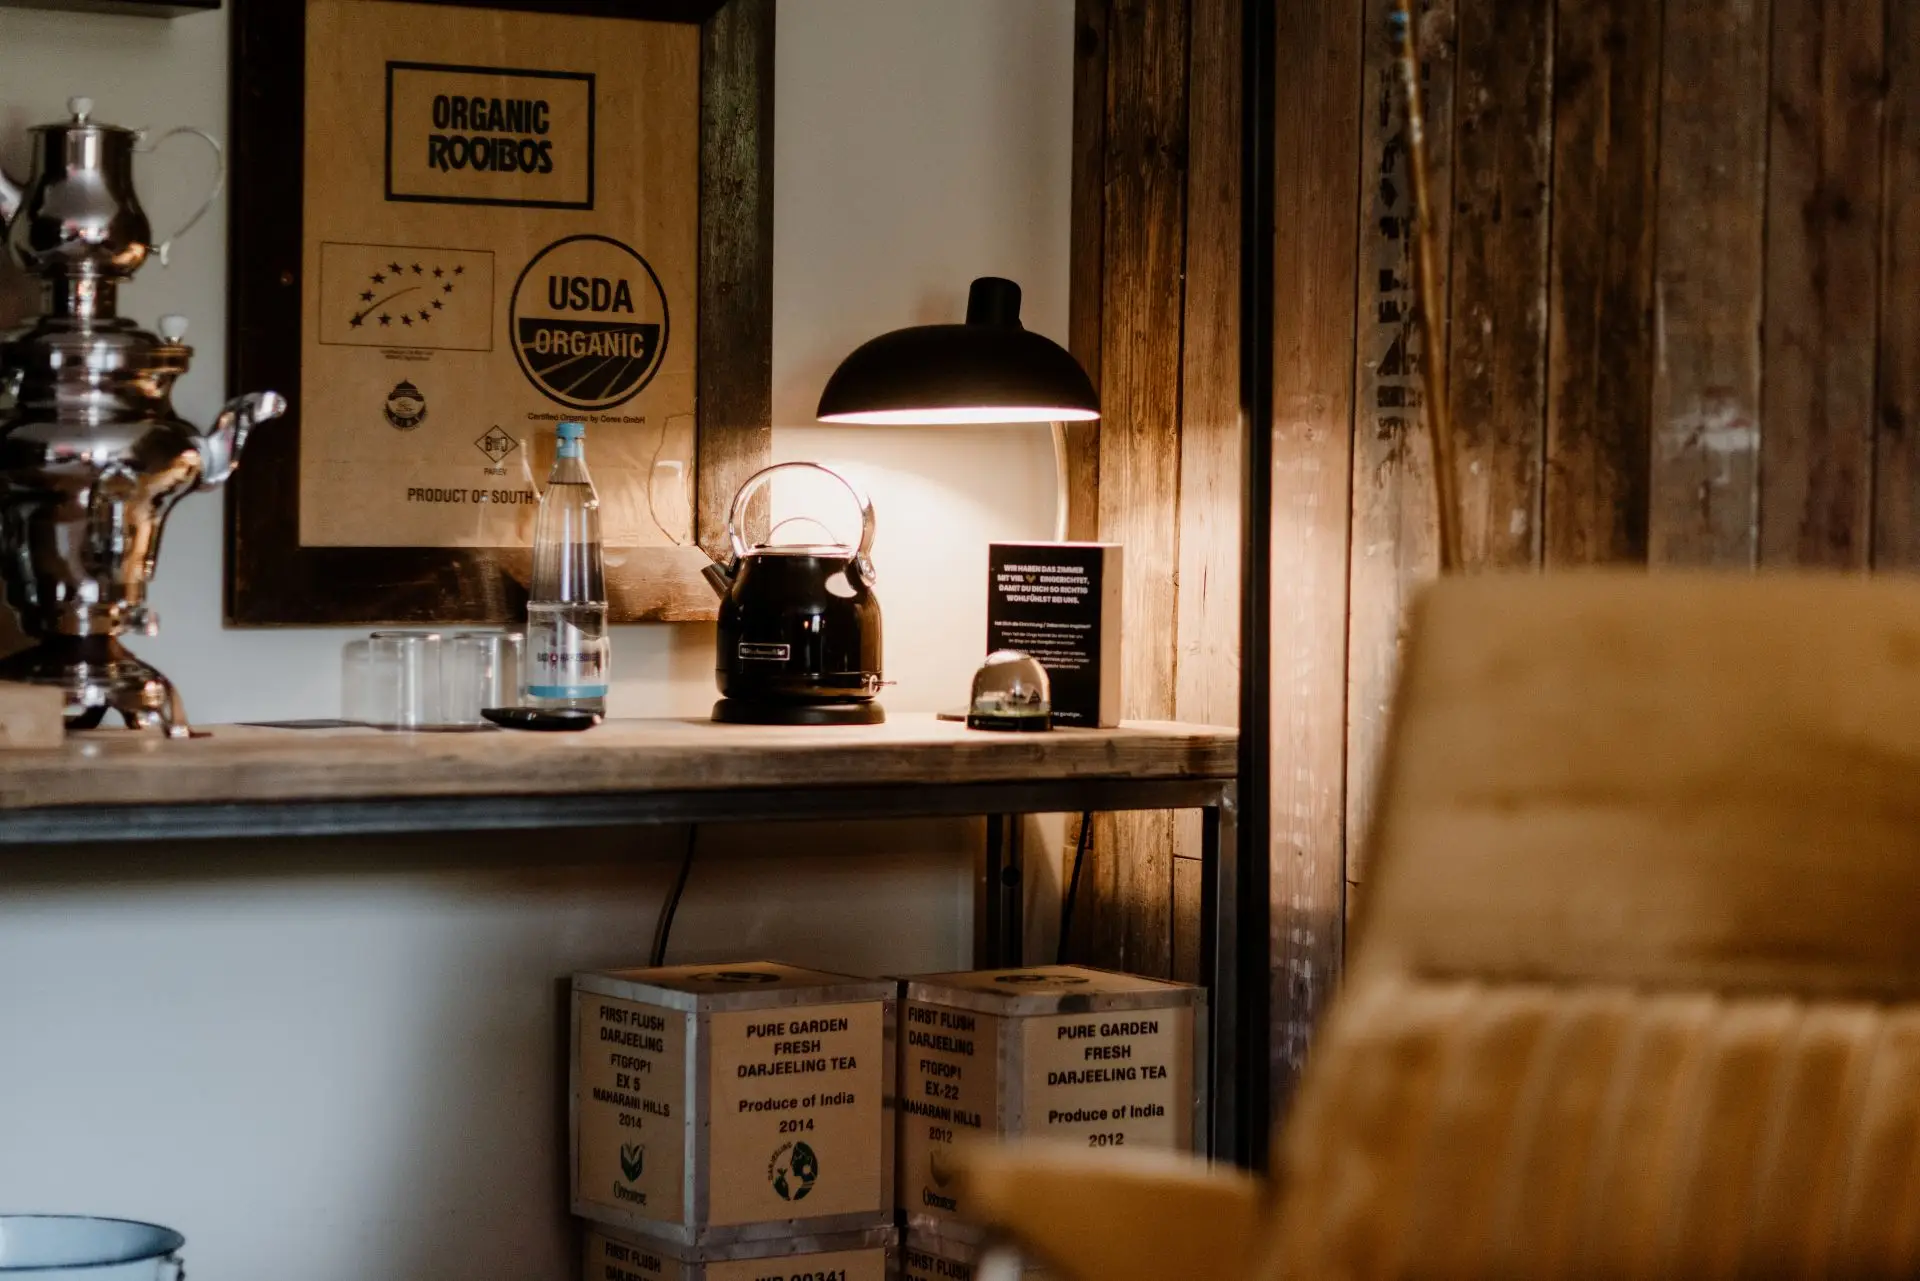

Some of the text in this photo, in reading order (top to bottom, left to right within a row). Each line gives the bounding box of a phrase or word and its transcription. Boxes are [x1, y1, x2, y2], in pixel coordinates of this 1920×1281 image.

[433, 94, 550, 134] ORGANIC
[428, 135, 553, 173] ROOIBOS
[549, 276, 634, 313] USDA
[534, 328, 644, 360] ORGANIC
[528, 412, 558, 421] Certified
[560, 413, 588, 423] Organic
[590, 414, 599, 424] by
[622, 415, 646, 424] GmbH
[407, 487, 534, 505] PRODUCT OF SOUTH
[997, 574, 1009, 582] MIT
[1010, 574, 1024, 582] VIEL
[1004, 564, 1084, 574] WIR HABEN DAS ZIMMER
[998, 584, 1020, 592] DAMIT
[1060, 586, 1088, 595] RICHTIG
[1006, 594, 1051, 603] WOHLFÜHLST
[1052, 596, 1063, 604] BEI
[600, 1005, 665, 1032] FIRST FLUSH
[746, 1018, 848, 1038] PURE GARDEN
[908, 1006, 976, 1032] FIRST FLUSH
[600, 1026, 664, 1054] DARJEELING
[1058, 1021, 1158, 1040] PURE GARDEN
[774, 1040, 821, 1055] FRESH
[908, 1030, 974, 1056] DARJEELING
[1084, 1045, 1131, 1060] FRESH
[610, 1054, 652, 1073] FTGFOP1
[737, 1056, 857, 1078] DARJEELING TEA
[616, 1073, 641, 1092] EX 5
[1048, 1066, 1167, 1086] DARJEELING TEA
[925, 1080, 959, 1100] EX-22
[593, 1087, 670, 1117] MAHARANI HILLS
[738, 1092, 855, 1113] Produce of India
[619, 1112, 642, 1129] 2014
[902, 1098, 982, 1128] MAHARANI HILLS
[1048, 1104, 1164, 1124] Produce of India
[779, 1118, 814, 1133] 2014
[929, 1126, 953, 1144] 2012
[1088, 1133, 1124, 1147] 2012
[606, 1241, 661, 1273] FIRST FLUSH
[937, 1259, 970, 1281] FLUSH
